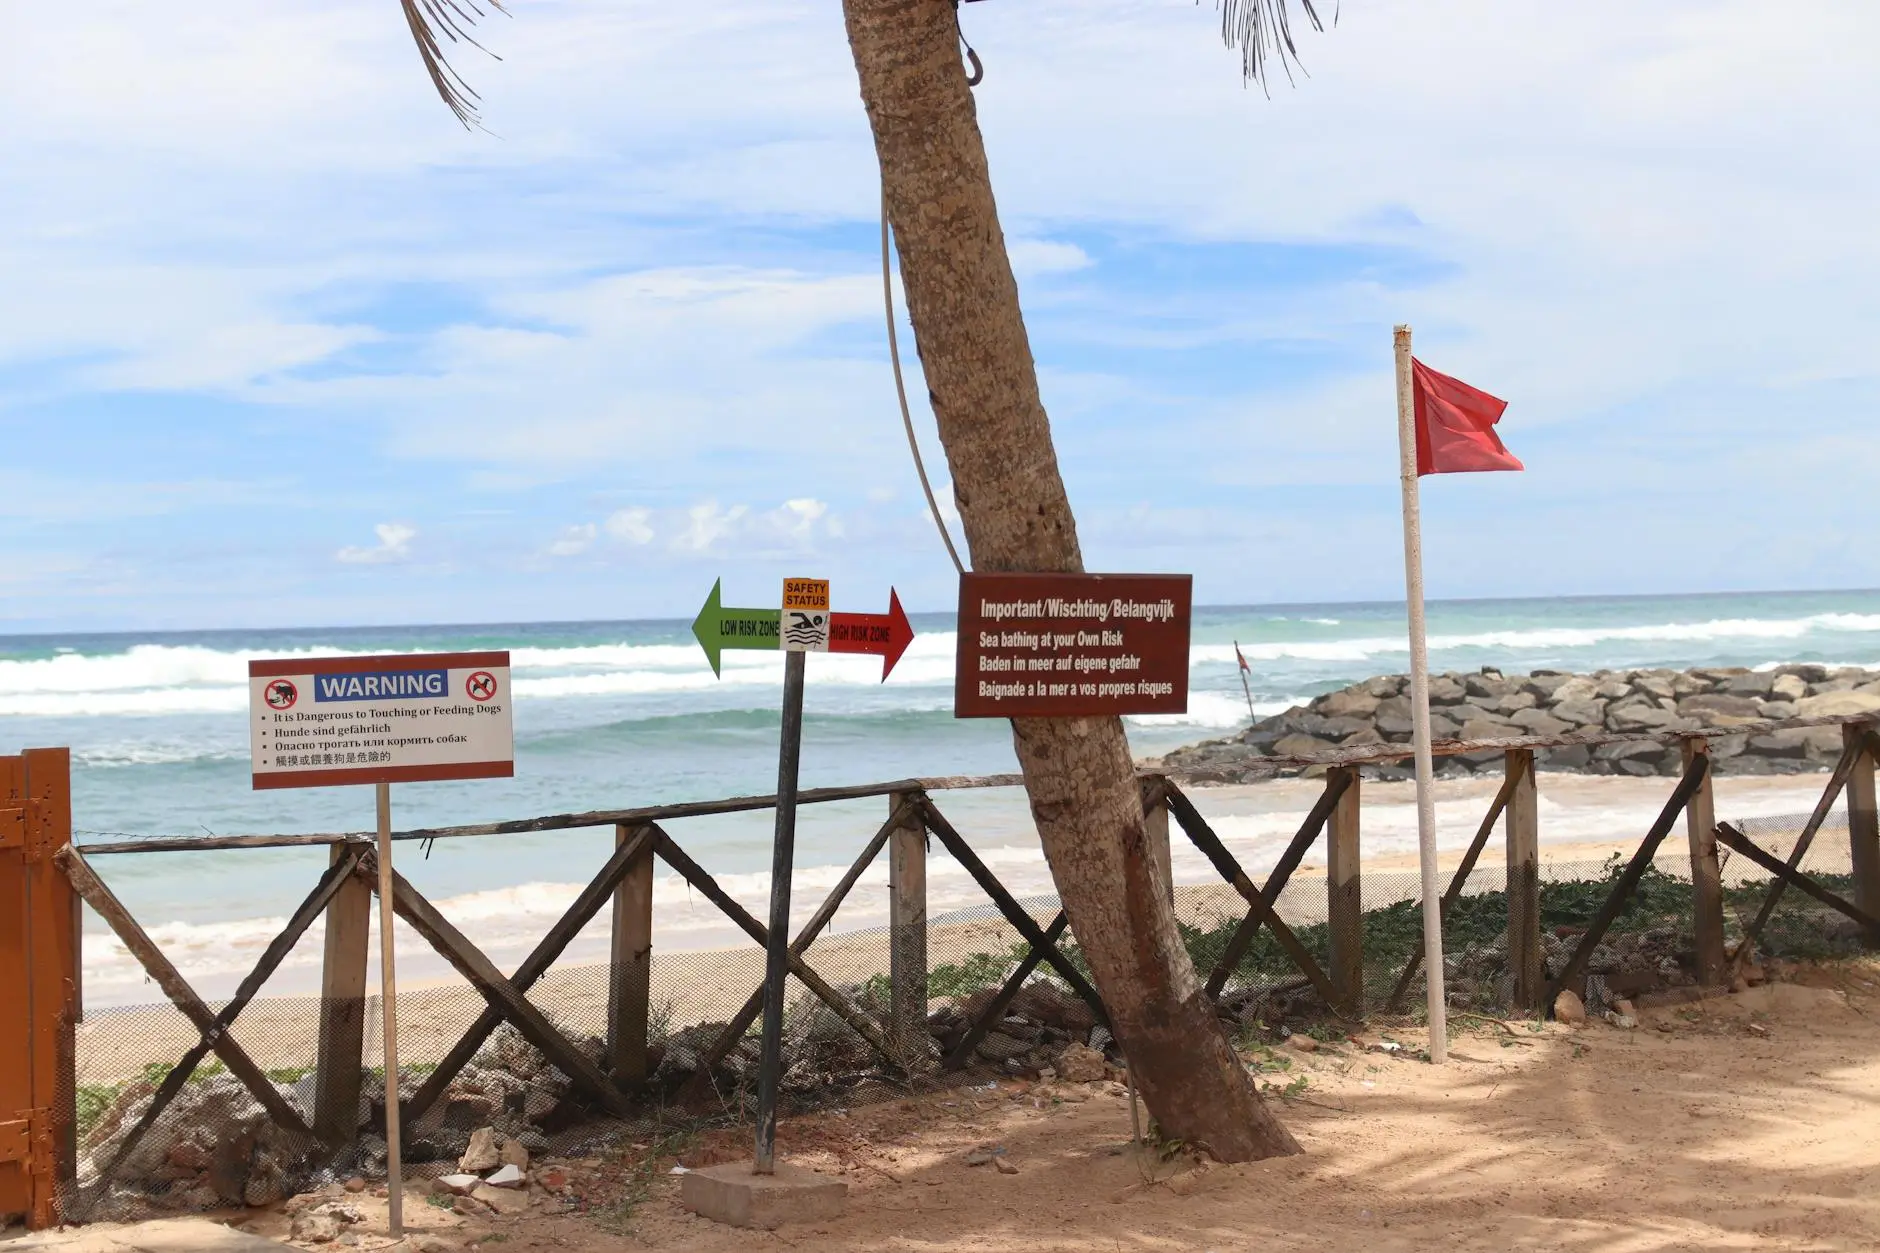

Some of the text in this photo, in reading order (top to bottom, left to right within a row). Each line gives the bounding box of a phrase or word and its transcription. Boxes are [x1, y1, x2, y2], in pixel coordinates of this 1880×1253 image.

[786, 582, 826, 593] SAFETY
[786, 595, 826, 606] STATUS
[720, 620, 780, 637] LOW RISK ZONE
[830, 624, 891, 643] HIGH RISK ZONE
[979, 630, 1123, 651] Sea bathing at your Own Risk
[979, 654, 1141, 673] Baden im meer auf eigene gefahr
[320, 673, 442, 698] WARNING
[978, 679, 1173, 700] Baignade a la mer a vos propres risques
[274, 713, 283, 722] It
[285, 712, 294, 722] is
[296, 712, 354, 722] Dangerous
[356, 710, 367, 719] to
[368, 708, 418, 718] Touching
[433, 705, 474, 716] Feeding
[476, 704, 502, 715] Dogs
[275, 723, 391, 738] Hunde sind gefährlich
[275, 734, 468, 751] Опасно трогать или кормить собак
